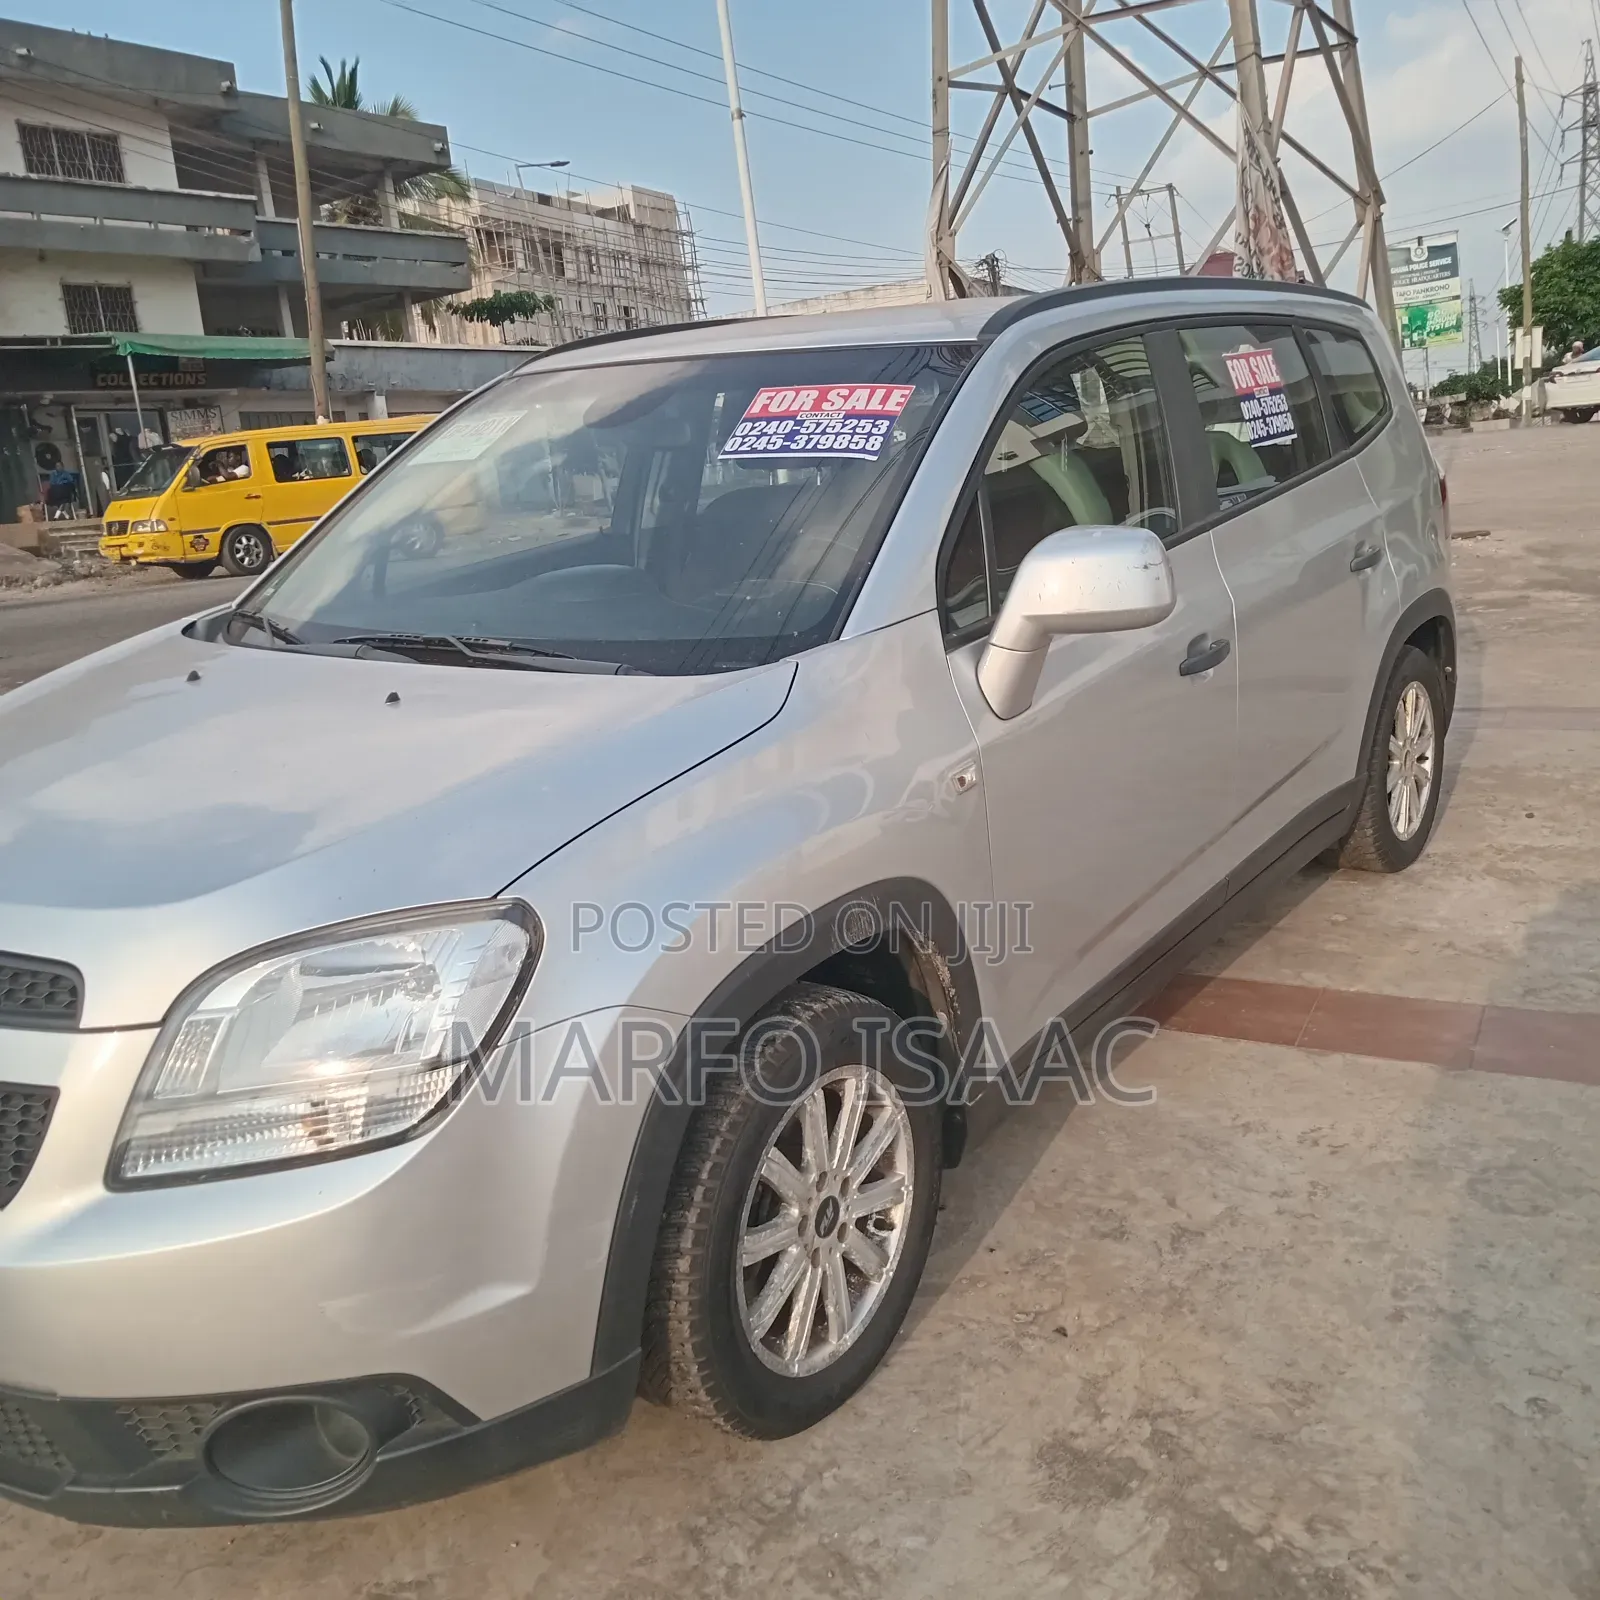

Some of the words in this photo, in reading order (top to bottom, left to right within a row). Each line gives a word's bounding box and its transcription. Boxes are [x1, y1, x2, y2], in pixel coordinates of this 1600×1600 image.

[1409, 262, 1428, 271] POLICE
[1429, 256, 1452, 268] SERVICE
[97, 373, 207, 387] COLECTIONS
[1226, 358, 1255, 390] FOR
[1249, 354, 1281, 386] SALE
[750, 389, 820, 414] FOR
[821, 387, 910, 413] SALE
[1240, 394, 1288, 420] 0240-575253
[171, 408, 217, 422] SIMMS
[799, 411, 842, 419] CONTACT
[735, 419, 890, 436] 0240-575253
[724, 434, 884, 452] 0245-379858
